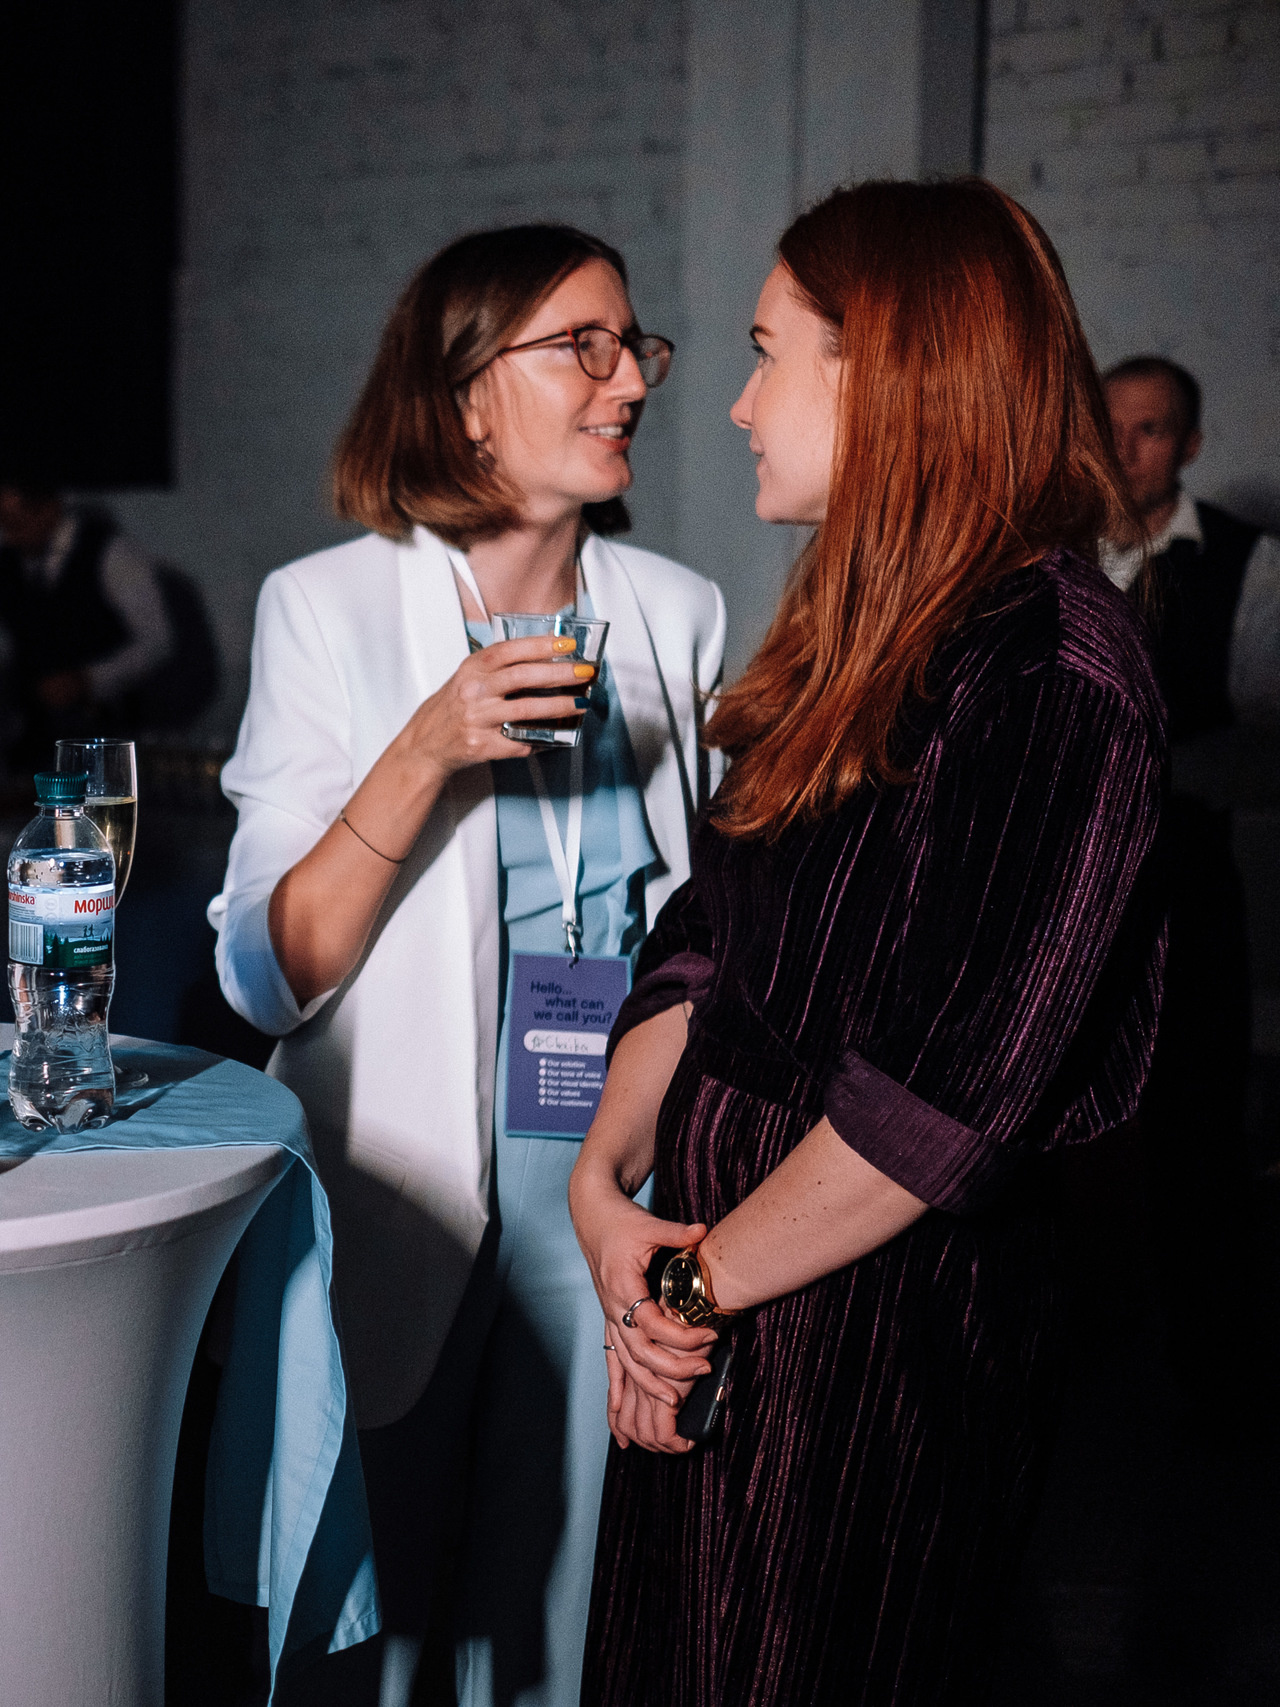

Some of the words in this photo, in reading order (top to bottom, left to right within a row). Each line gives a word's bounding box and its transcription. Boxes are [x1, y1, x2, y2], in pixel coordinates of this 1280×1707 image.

[545, 996, 576, 1008] what
[580, 1000, 605, 1010] can
[533, 1011, 553, 1020] we
[556, 1010, 579, 1022] call
[582, 1011, 612, 1025] you?
[547, 1069, 560, 1077] Our
[547, 1098, 559, 1106] Our
